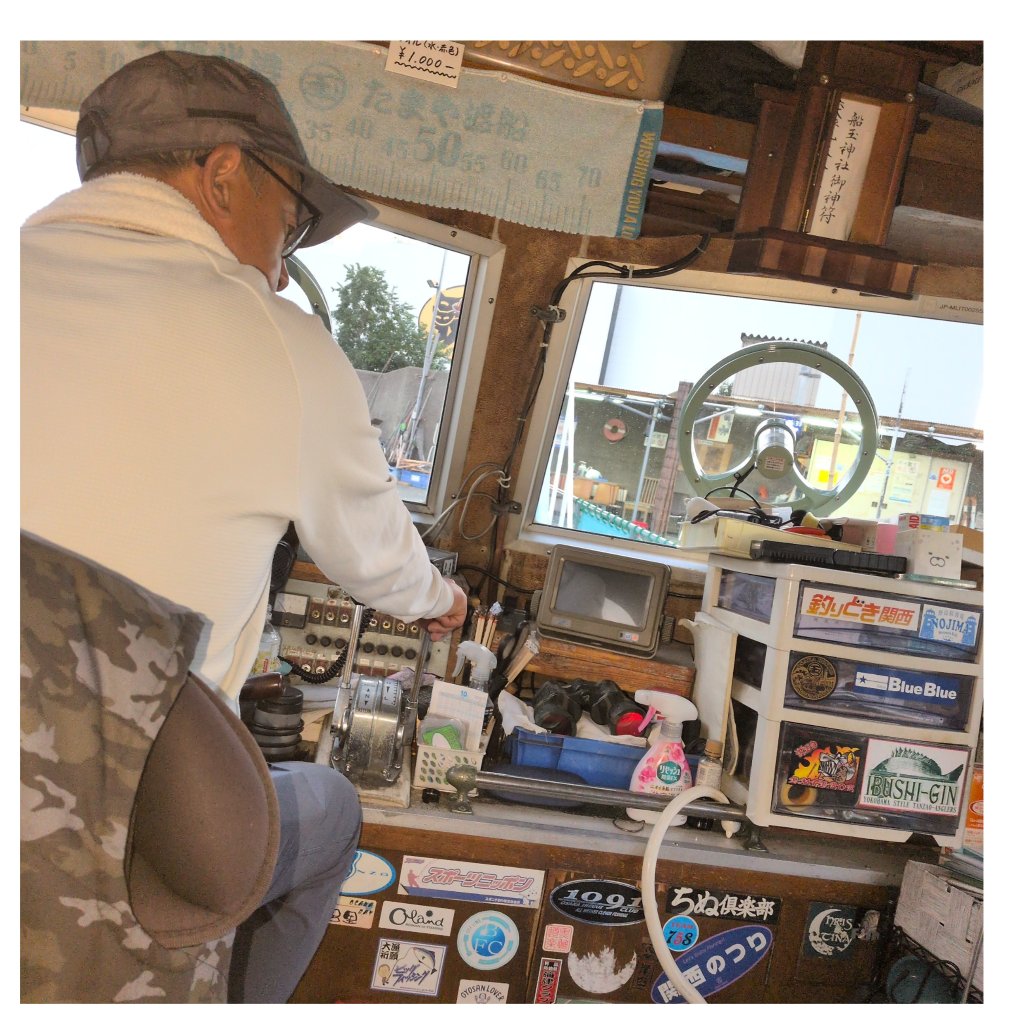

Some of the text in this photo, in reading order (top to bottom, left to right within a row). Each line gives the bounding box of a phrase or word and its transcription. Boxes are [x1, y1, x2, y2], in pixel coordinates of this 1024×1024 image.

[413, 125, 463, 167] 50
[631, 131, 657, 188] WISHING
[806, 593, 916, 627] 釣りどき関西
[931, 617, 970, 635] NOJIMA
[865, 775, 959, 806] IBUSHI-GIN
[422, 866, 535, 892] スポーツニッポン
[563, 889, 643, 910] 1091
[670, 886, 776, 921] ちぬ倶楽部
